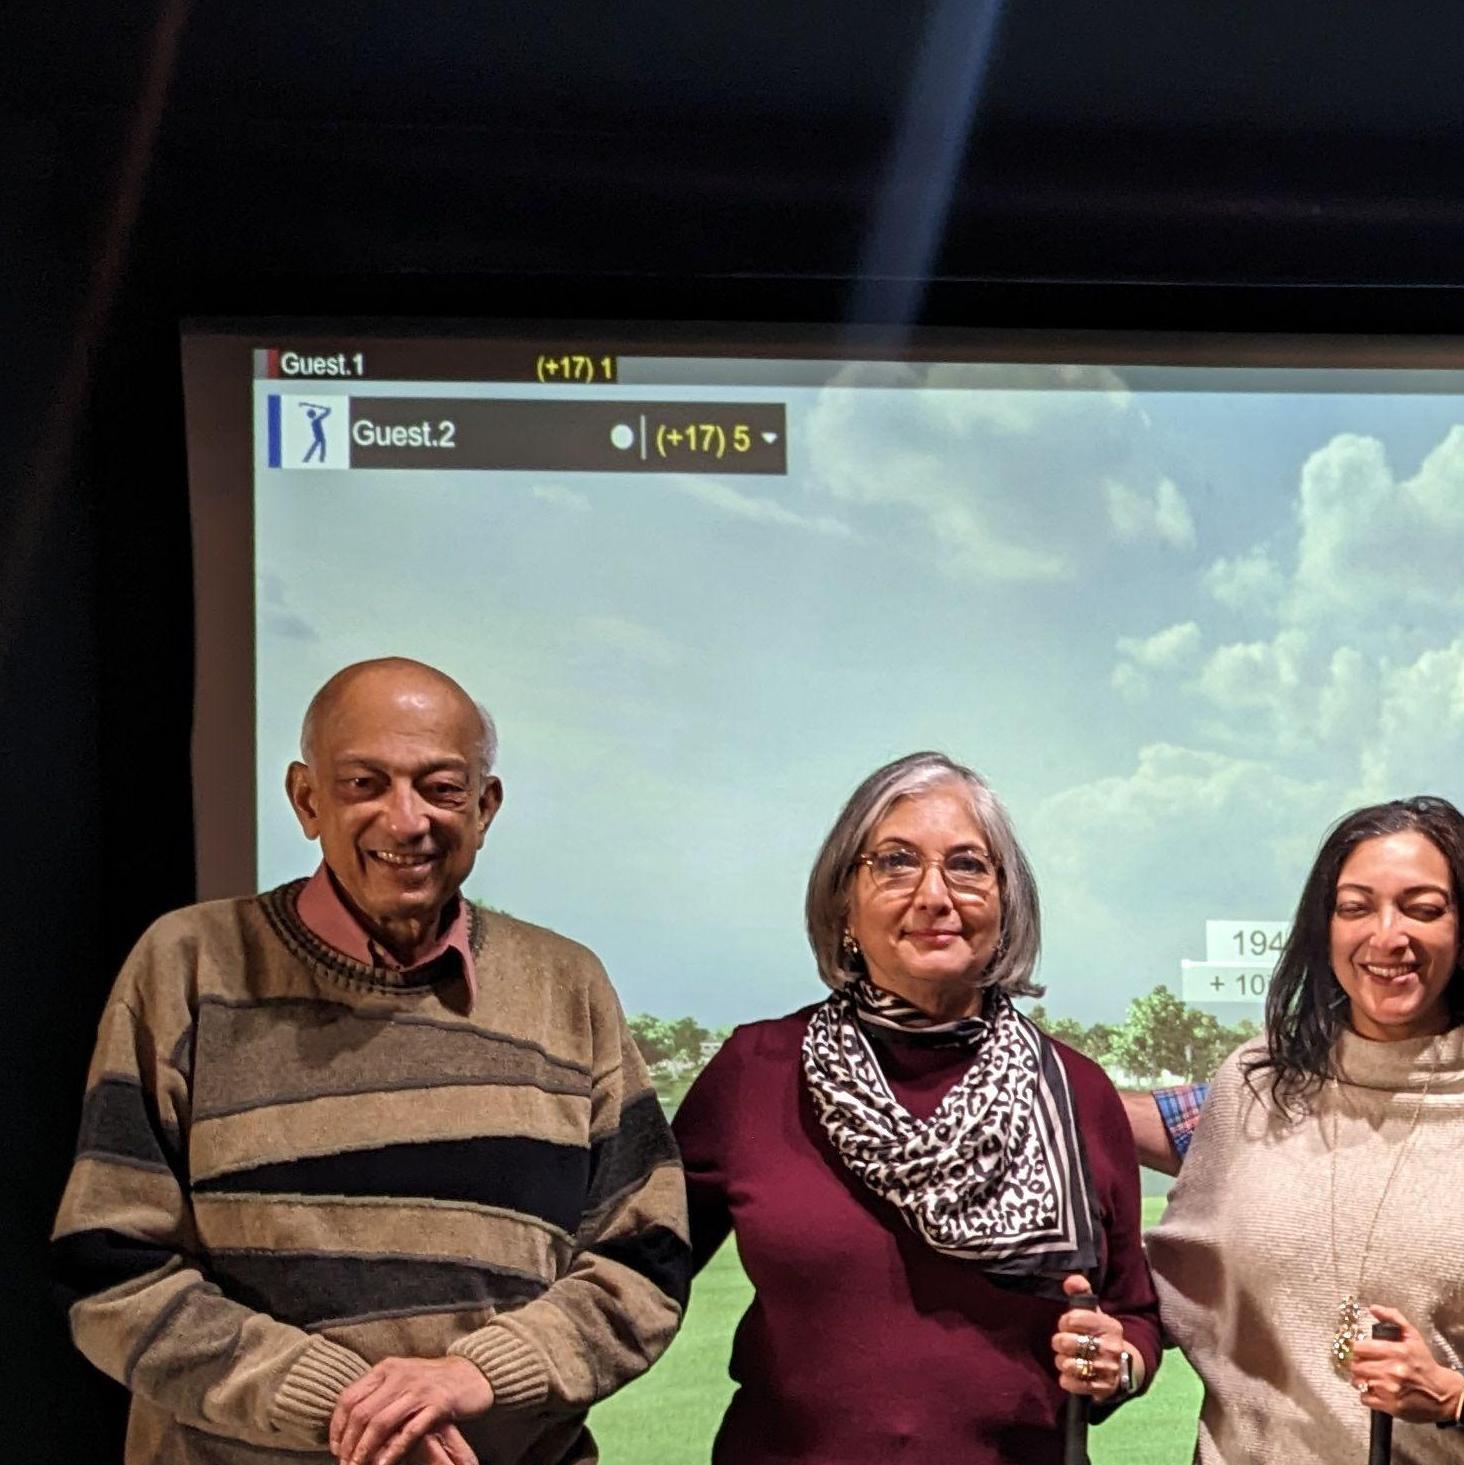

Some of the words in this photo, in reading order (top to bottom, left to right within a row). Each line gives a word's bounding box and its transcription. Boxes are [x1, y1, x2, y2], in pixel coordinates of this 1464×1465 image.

[281, 352, 364, 375] Guest.1
[537, 356, 594, 383] (+17)
[601, 357, 612, 379] 1
[353, 420, 456, 448] Guest.2
[657, 424, 726, 459] (+17)
[733, 424, 751, 452] 5
[1235, 973, 1271, 996] 10
